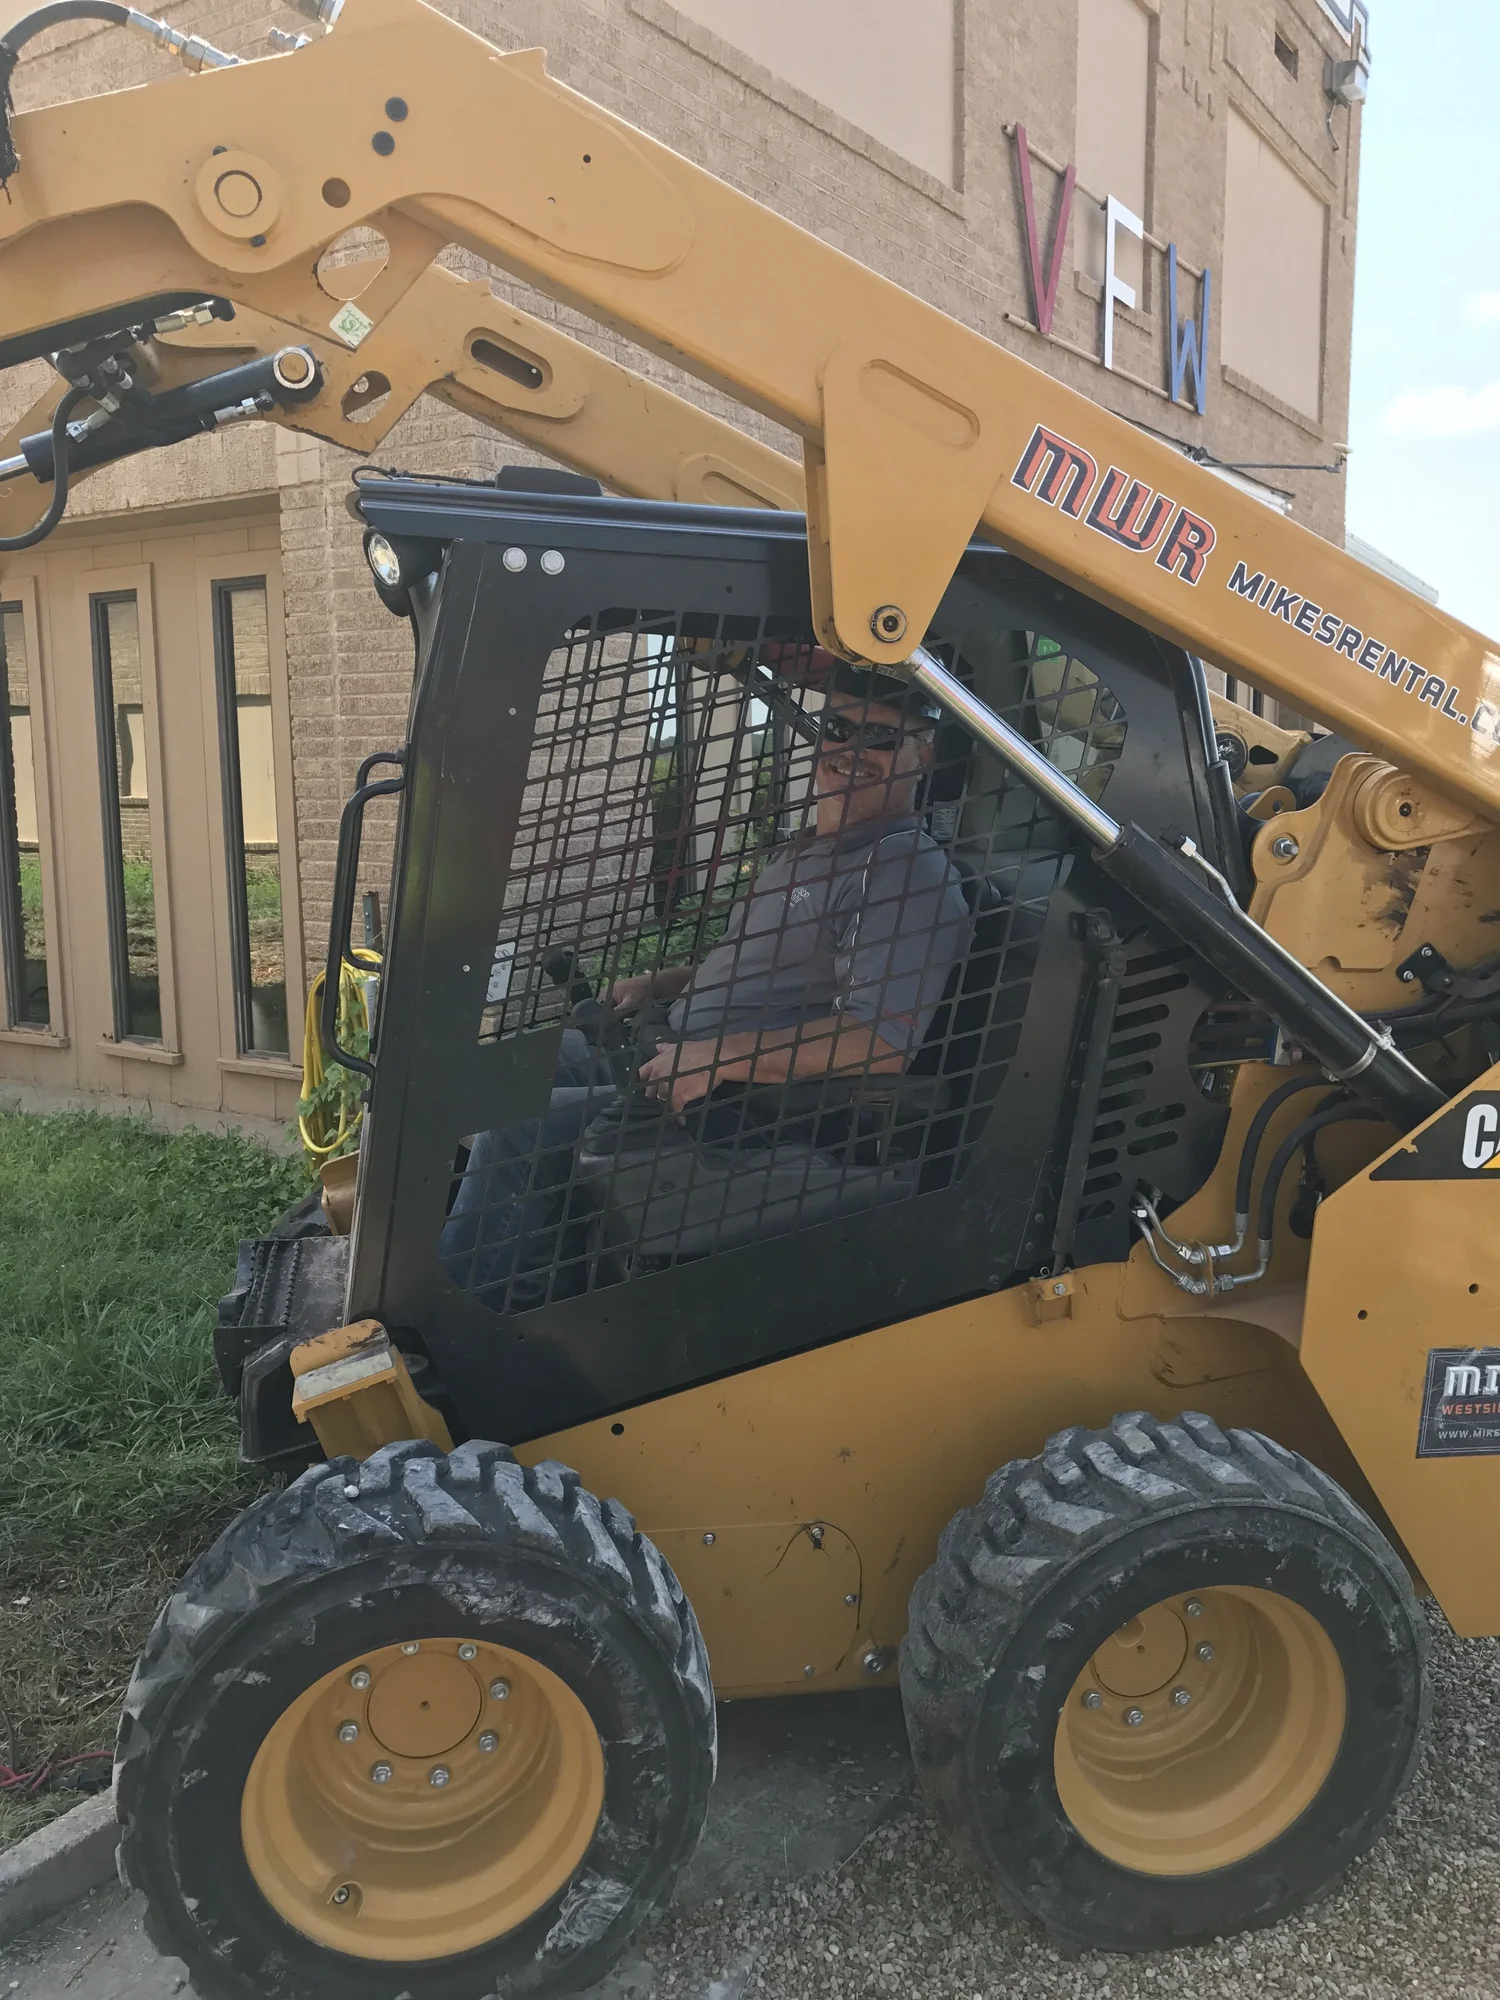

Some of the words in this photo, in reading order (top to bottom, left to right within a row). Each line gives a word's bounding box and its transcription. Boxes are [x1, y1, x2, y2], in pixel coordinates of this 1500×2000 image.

[1015, 121, 1211, 416] VFW
[1010, 423, 1217, 587] MWR
[1462, 1103, 1500, 1169] C
[1442, 1402, 1500, 1416] WESTSI
